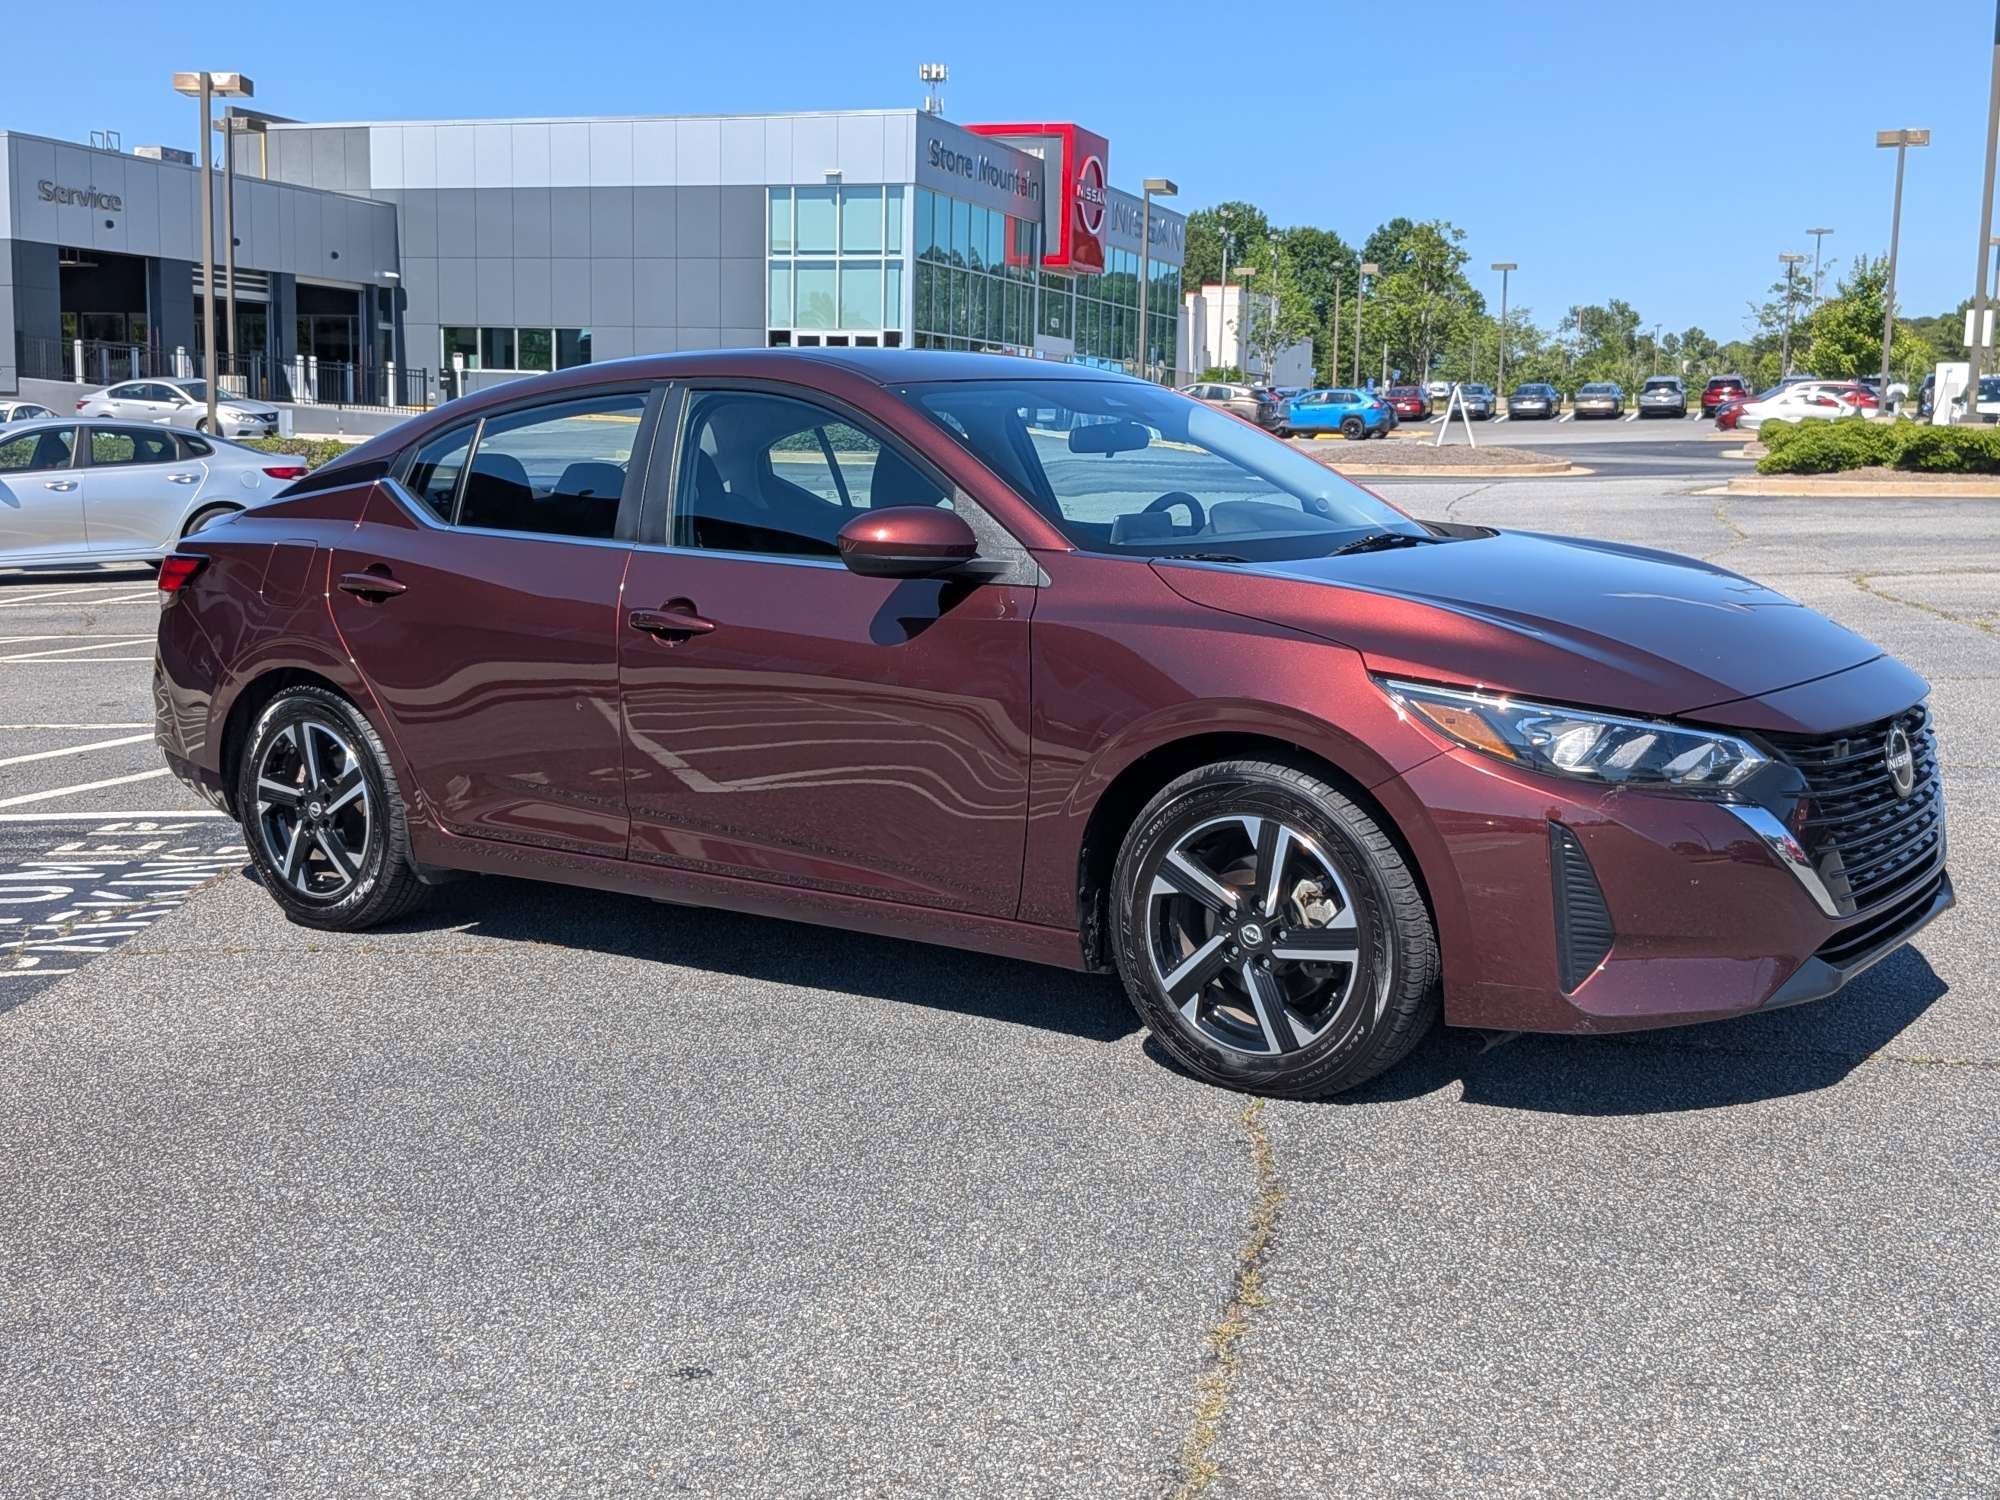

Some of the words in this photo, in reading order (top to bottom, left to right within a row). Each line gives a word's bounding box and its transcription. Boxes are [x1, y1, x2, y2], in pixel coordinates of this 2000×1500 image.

[928, 138, 973, 179] Stone
[978, 154, 1040, 201] Mountain
[38, 179, 122, 212] Service
